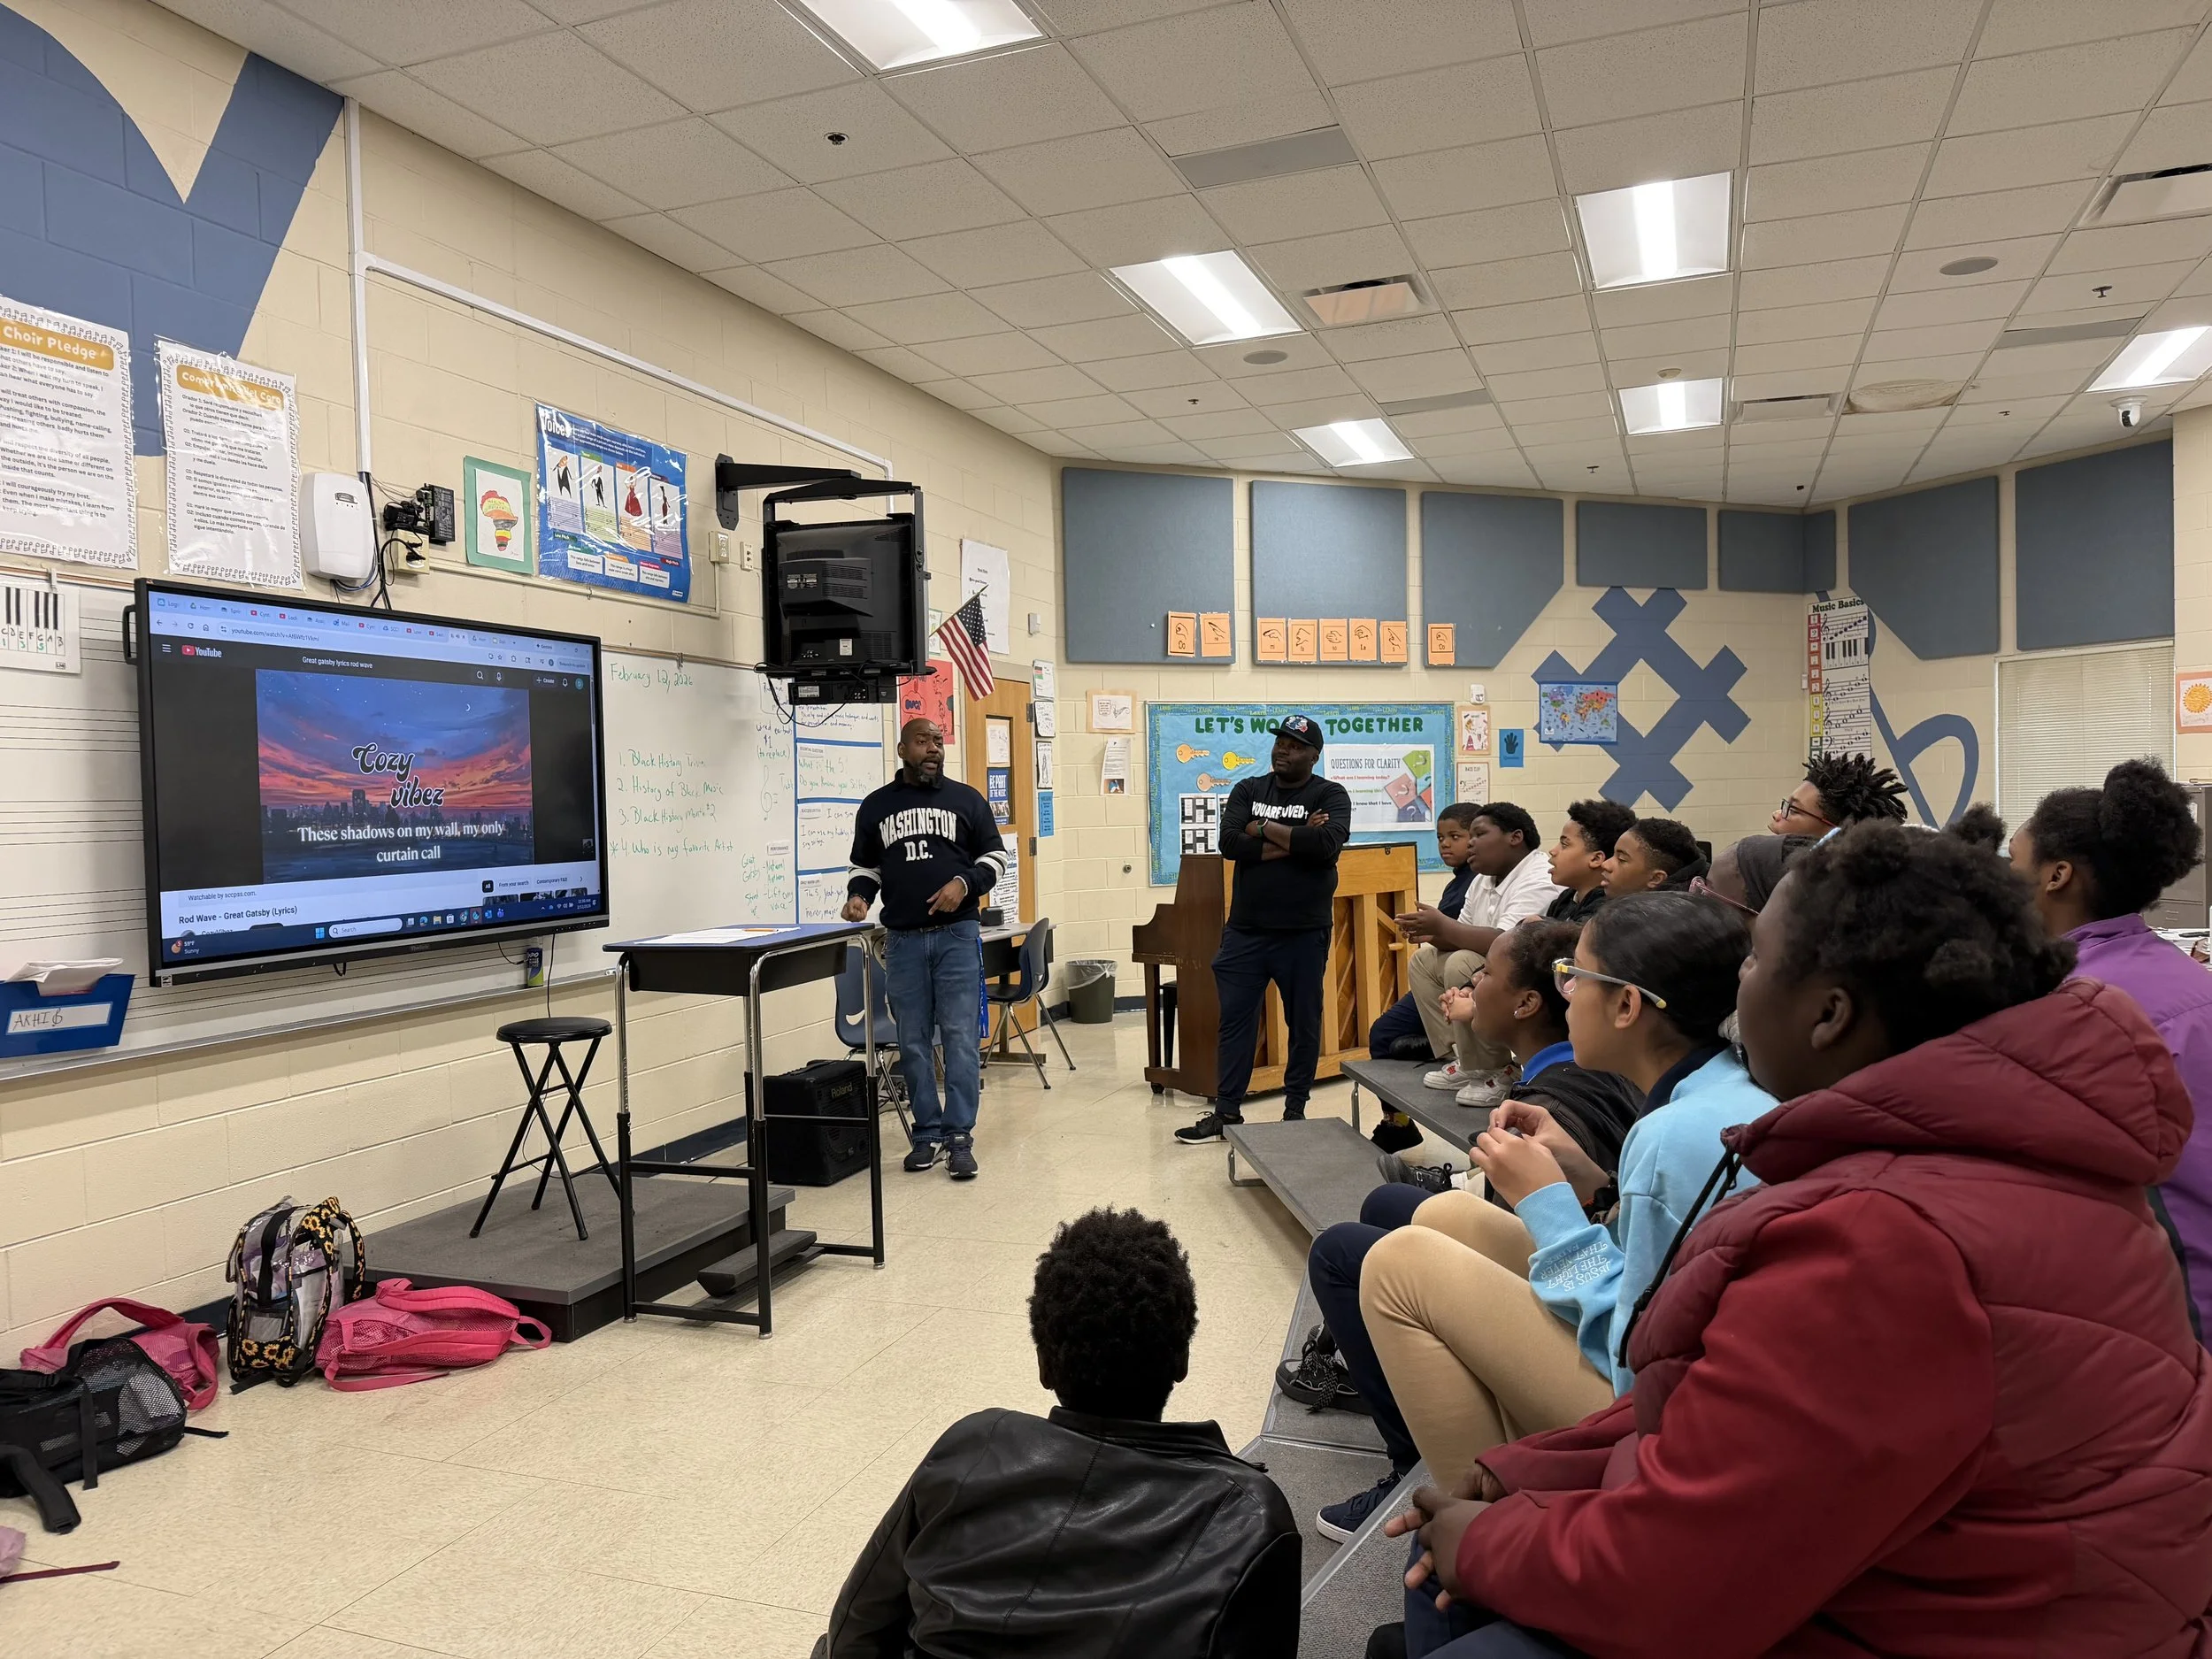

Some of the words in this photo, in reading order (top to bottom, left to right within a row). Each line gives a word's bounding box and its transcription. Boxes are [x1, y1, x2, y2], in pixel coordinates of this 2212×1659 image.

[4, 326, 42, 345] Choir
[48, 337, 96, 360] Pledge
[41, 356, 74, 368] responsible
[87, 365, 102, 375] listen
[28, 394, 48, 403] others
[62, 402, 96, 414] compassion,
[260, 391, 281, 403] Coro
[25, 409, 49, 420] fighting,
[50, 415, 74, 426] bullying,
[75, 421, 112, 434] name-calling,
[61, 410, 83, 419] treated.
[18, 482, 56, 495] courageously
[1812, 602, 1836, 613] Music
[1838, 597, 1864, 610] Basics
[57, 636, 63, 647] B
[195, 647, 222, 658] YouTube
[611, 663, 650, 688] February
[657, 669, 671, 695] 12,
[674, 672, 693, 687] 2026
[1195, 717, 1244, 733] LET'S
[1325, 715, 1424, 736] TOGETHER
[764, 734, 772, 749] $1
[351, 742, 416, 783] Cozy
[619, 751, 626, 767] 1.
[628, 749, 656, 766] Black
[658, 753, 682, 777] History
[1331, 758, 1363, 770] QUESTIONS
[1364, 758, 1375, 768] FOR
[1377, 758, 1402, 769] CLARITY
[617, 777, 628, 792] 2.
[633, 775, 662, 802] History
[665, 781, 674, 798] of
[703, 782, 724, 795] Music
[990, 775, 995, 788] BE
[995, 775, 1007, 788] PART
[390, 776, 445, 808] vibez
[619, 808, 629, 826] 3.
[630, 805, 659, 825] Black
[662, 809, 683, 833] History
[879, 807, 957, 849] WASHINGTON
[297, 826, 338, 842] These
[341, 825, 395, 841] shadows
[397, 826, 412, 837] on
[416, 826, 434, 840] my
[434, 822, 461, 837] wall,
[463, 824, 480, 837] my
[481, 820, 504, 836] only
[376, 847, 419, 863] curtain
[421, 845, 442, 860] call
[621, 837, 629, 856] 4.
[633, 839, 649, 854] Who
[654, 842, 662, 856] is
[667, 845, 679, 859] my
[683, 837, 710, 856] favorite
[715, 838, 733, 852] Artist
[904, 840, 933, 862] D.C.
[179, 916, 194, 925] Rod
[245, 909, 270, 918] Gatsby
[272, 905, 298, 916] (Lyrics)
[831, 1083, 853, 1098] Roland
[1575, 1240, 1608, 1261] THAT
[1540, 1259, 1573, 1279] NEVER
[1581, 1255, 1607, 1271] THE
[1547, 1263, 1578, 1289] LIGHT
[1575, 1261, 1610, 1286] JESUS
[1564, 1280, 1575, 1292] IS
